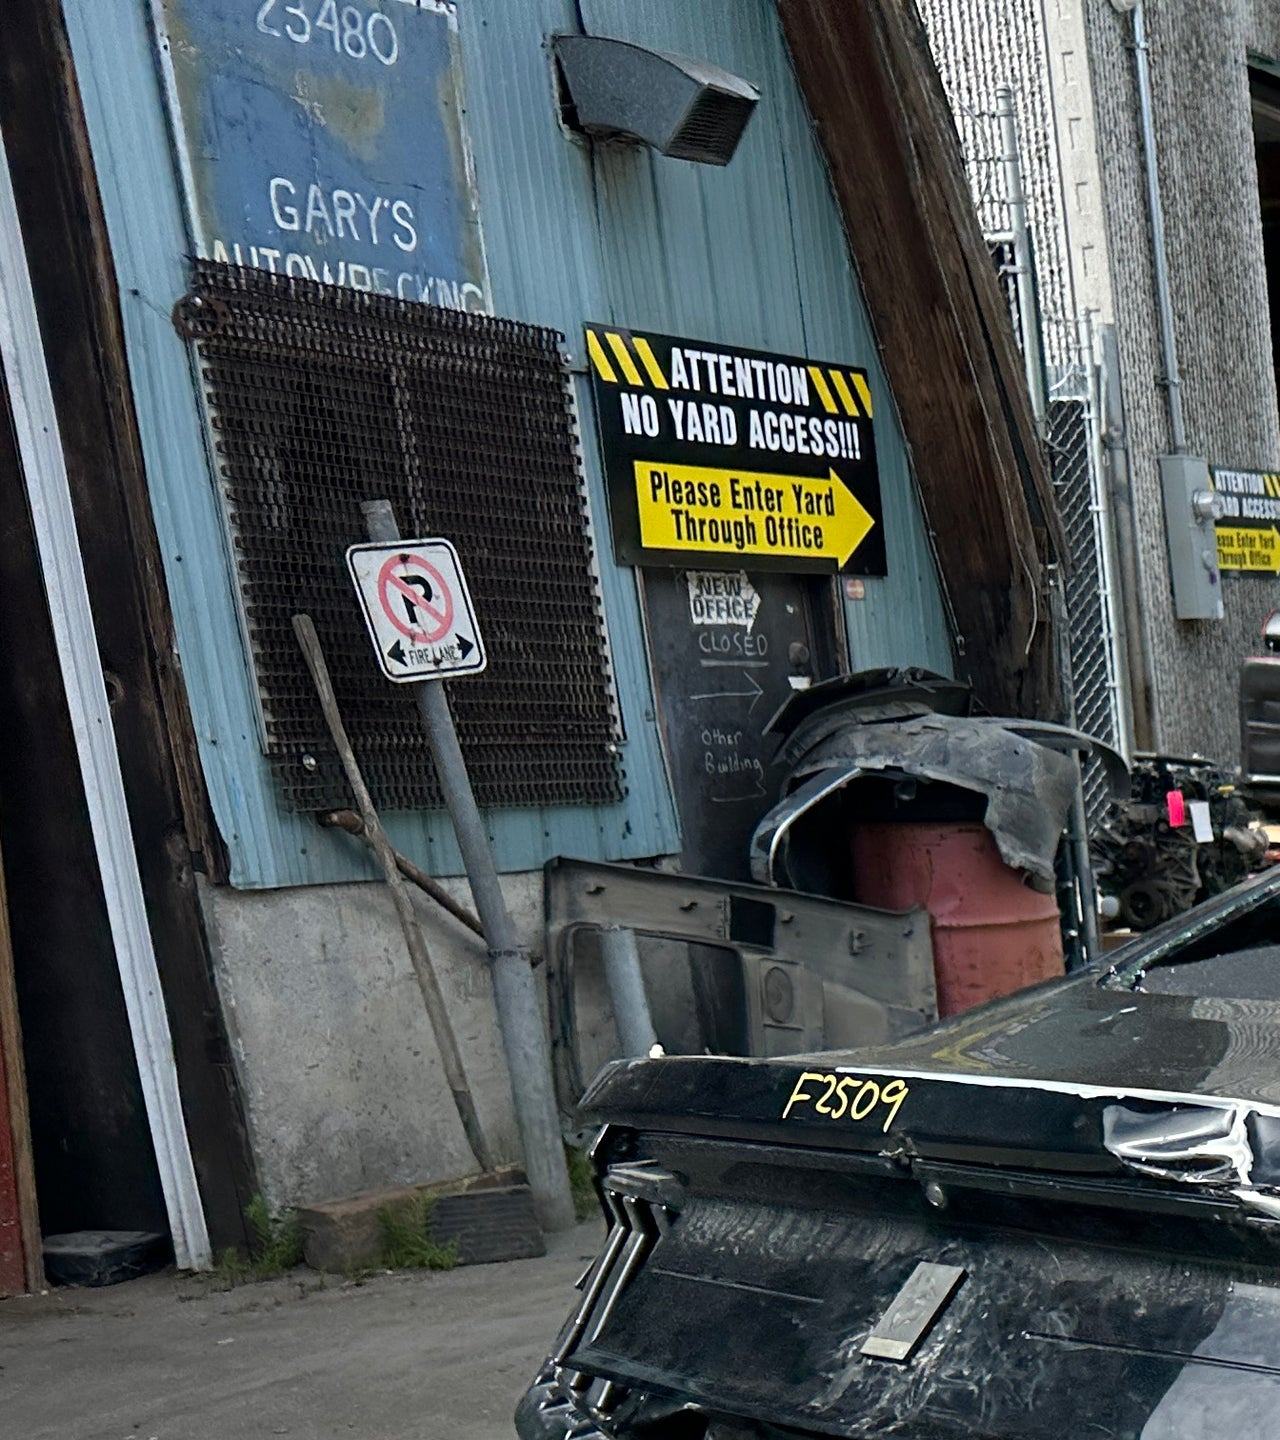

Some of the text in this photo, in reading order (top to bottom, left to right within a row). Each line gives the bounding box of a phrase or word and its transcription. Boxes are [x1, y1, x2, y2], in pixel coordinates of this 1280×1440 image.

[256, 0, 399, 66] 23480
[269, 176, 418, 252] GARY'S
[670, 346, 811, 407] ATTENTION
[619, 391, 862, 461] NO YARD ACCESS!!!
[649, 469, 836, 517] Please Enter Yard
[1214, 469, 1266, 495] ATTENTION
[670, 508, 824, 550] Through Office
[699, 575, 743, 597] NEW
[692, 595, 757, 619] OFFICE
[408, 647, 432, 667] FIRE
[698, 630, 769, 657] CLOSED
[700, 727, 744, 746] Other
[704, 750, 765, 781] Building
[781, 1071, 910, 1134] F2509
